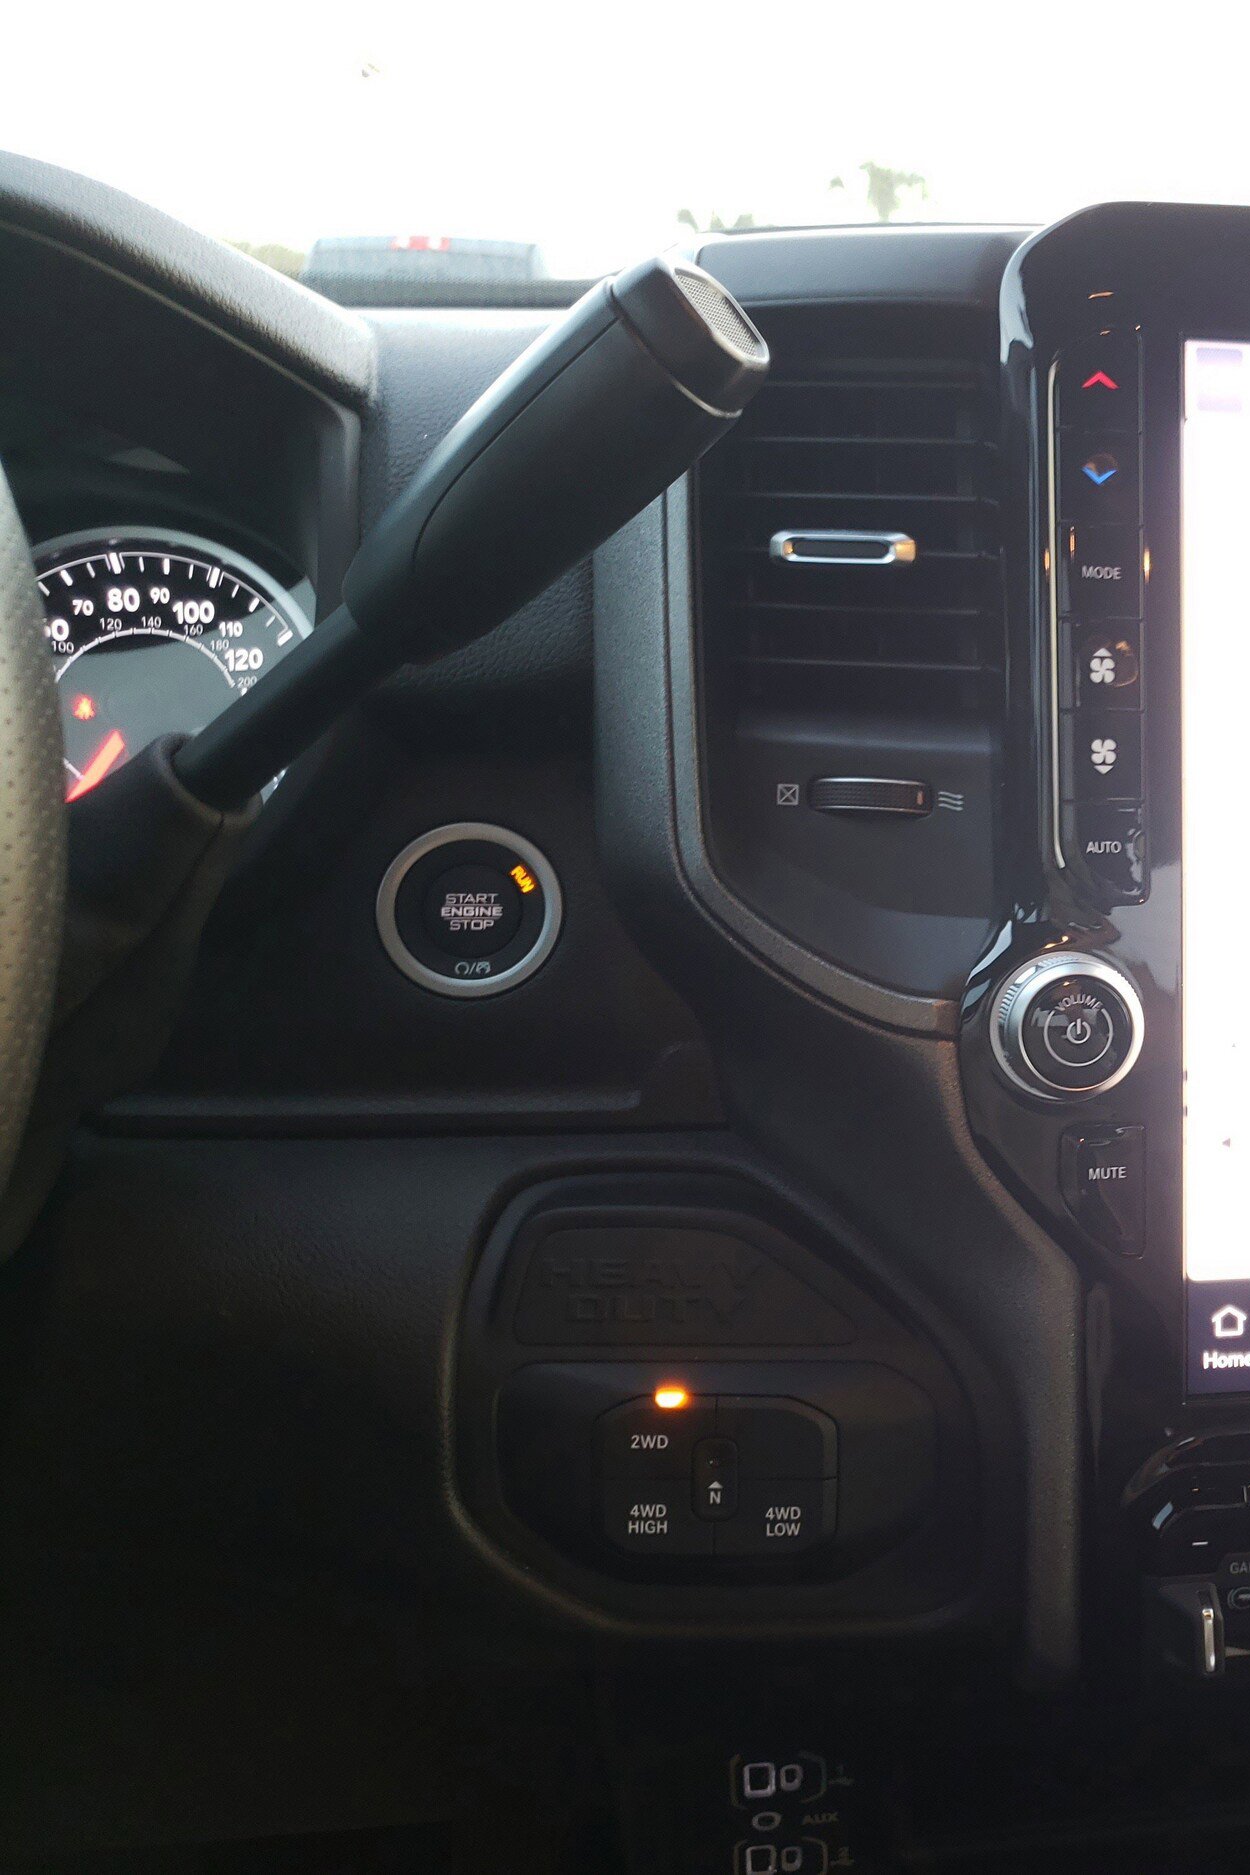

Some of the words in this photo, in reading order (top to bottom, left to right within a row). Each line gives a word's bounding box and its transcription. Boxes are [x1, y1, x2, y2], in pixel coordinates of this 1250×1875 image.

[1081, 565, 1122, 582] MODE
[106, 588, 140, 613] 80
[150, 587, 170, 605] 90
[72, 599, 94, 616] 70
[172, 600, 215, 624] 100
[44, 618, 69, 642] 0
[99, 618, 122, 632] 120
[141, 616, 162, 629] 140
[219, 621, 243, 638] 110
[184, 624, 203, 637] 160
[51, 641, 75, 654] 100
[210, 639, 229, 652] 180
[224, 649, 263, 672] 120
[1086, 840, 1122, 855] AUTO
[510, 865, 535, 894] RUN
[445, 893, 499, 904] START
[440, 906, 504, 918] ENGINE
[449, 919, 495, 931] STOP
[1055, 994, 1104, 1011] VOLUME
[1088, 1166, 1127, 1181] MUTE
[630, 1434, 669, 1450] 2WD
[709, 1490, 722, 1505] N
[630, 1504, 667, 1518] 4WD
[765, 1506, 801, 1521] 4WD
[628, 1519, 668, 1535] HIGH
[766, 1522, 801, 1537] LOW
